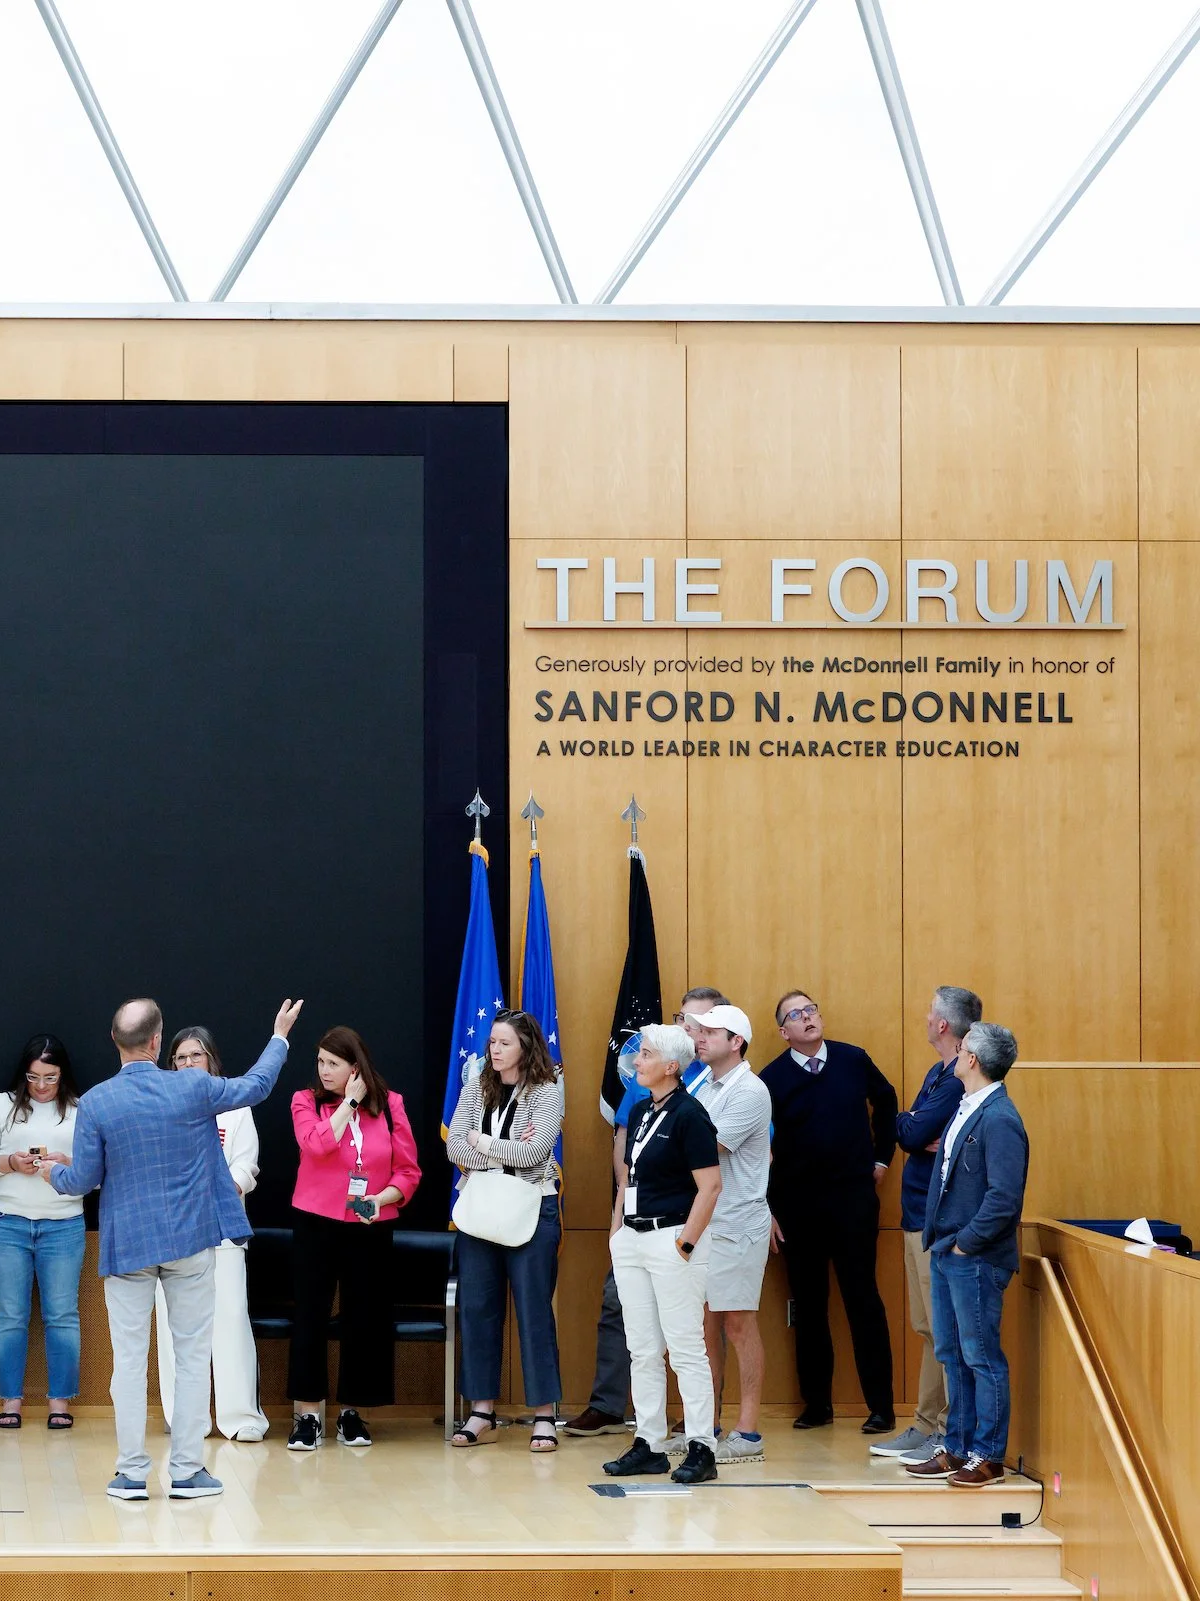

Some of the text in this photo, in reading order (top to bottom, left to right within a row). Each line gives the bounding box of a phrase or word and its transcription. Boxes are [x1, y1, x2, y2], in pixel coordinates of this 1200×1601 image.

[536, 557, 1113, 623] THE FORUM
[535, 655, 1116, 678] Generously provided by the McDonnell Family in honor of
[534, 690, 1074, 724] SANFORD N. McDONNELL
[536, 740, 1019, 758] A WORLD LEADER IN CHARACTER EDUCATION
